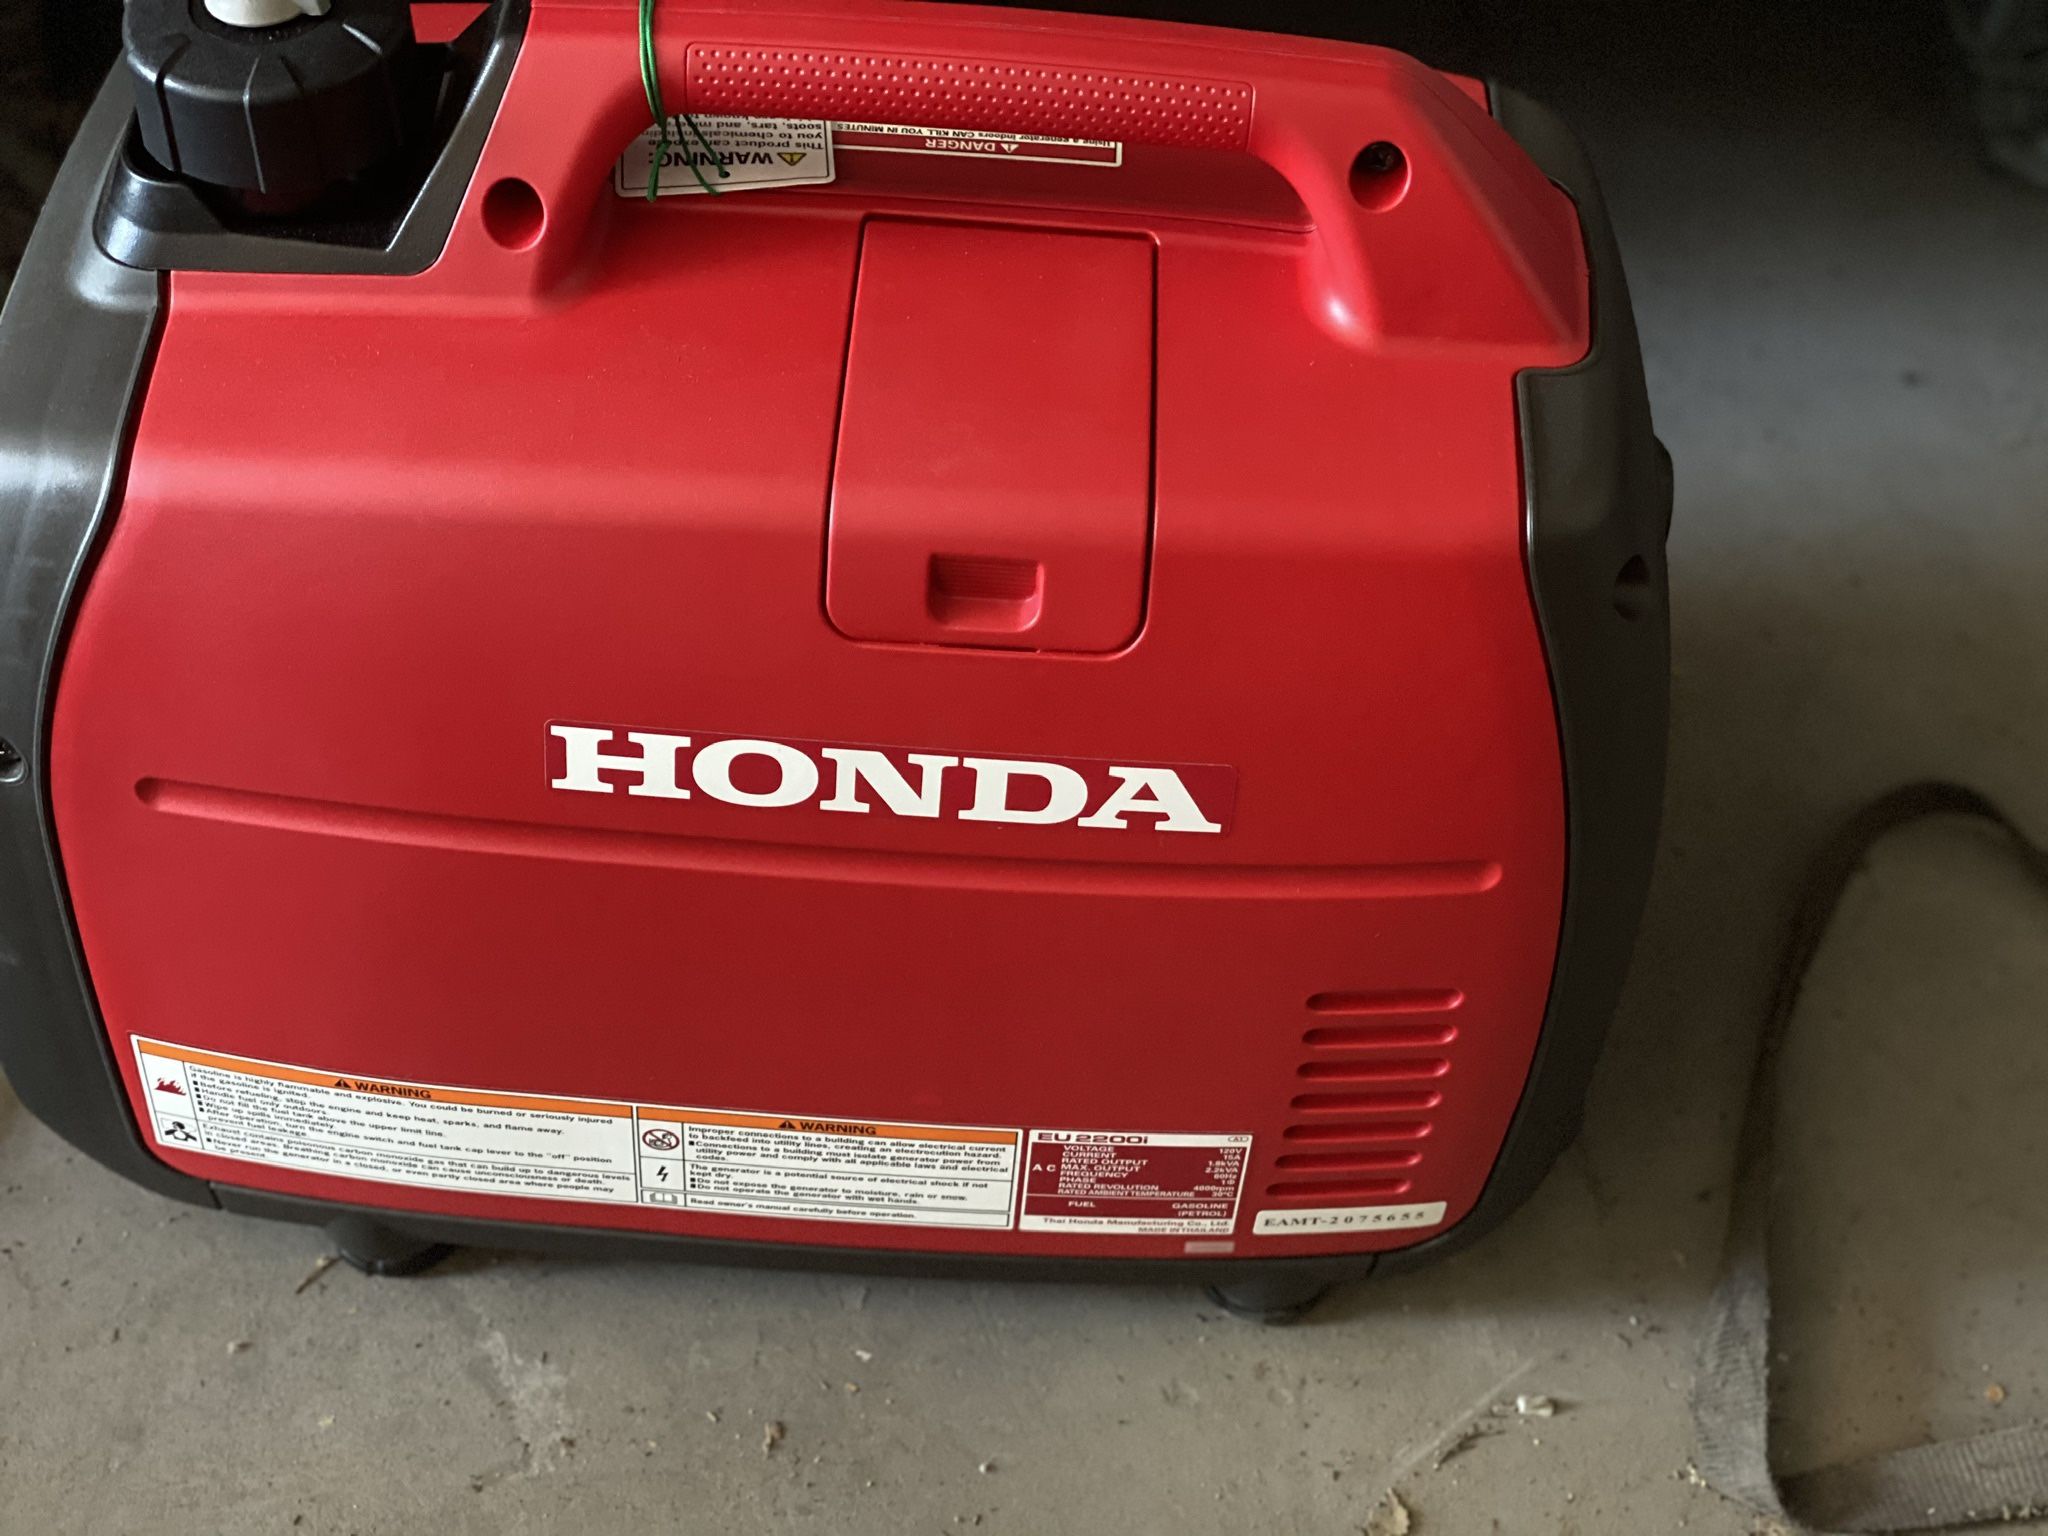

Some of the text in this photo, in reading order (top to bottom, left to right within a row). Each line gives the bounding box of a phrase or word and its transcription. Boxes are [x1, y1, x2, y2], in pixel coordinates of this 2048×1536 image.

[717, 121, 741, 129] and
[747, 121, 777, 130] tars,
[782, 122, 822, 130] soots,
[837, 122, 884, 132] MINUTES
[703, 130, 774, 139] chemicals
[901, 127, 923, 135] YOU
[979, 132, 1016, 141] indoors
[735, 140, 790, 149] product
[795, 141, 824, 150] This
[925, 138, 996, 152] DANGER
[550, 725, 1222, 833] HONDA
[354, 1080, 432, 1099] WARNING
[354, 1093, 402, 1106] explosive.
[408, 1100, 427, 1108] You
[429, 1102, 458, 1111] could
[475, 1107, 513, 1116] burned
[529, 1112, 575, 1122] seriously
[577, 1116, 613, 1125] injured
[800, 1121, 877, 1136] WARNING
[688, 1125, 735, 1136] Improper
[737, 1129, 798, 1139] connections
[824, 1136, 864, 1145] building
[917, 1142, 966, 1150] electrical
[701, 1133, 749, 1142] backfeed
[773, 1139, 801, 1148] utility
[804, 1141, 830, 1150] lines,
[833, 1143, 875, 1153] creating
[894, 1147, 961, 1156] electrocution
[694, 1140, 757, 1150] Connections
[782, 1147, 823, 1156] building
[889, 1154, 939, 1163] generator
[695, 1153, 728, 1161] codes.
[695, 1147, 722, 1155] utility
[781, 1154, 818, 1162] comply
[859, 1159, 911, 1168] applicable
[1093, 1164, 1140, 1172] OUTPUT
[689, 1170, 711, 1178] kept
[710, 1165, 760, 1175] generator
[783, 1170, 827, 1180] potential
[879, 1177, 927, 1185] electrical
[1059, 1170, 1129, 1178] FREQUENCY
[732, 1181, 768, 1189] expose
[789, 1184, 838, 1194] generator
[854, 1189, 900, 1197] moisture,
[732, 1186, 770, 1195] operate
[790, 1190, 841, 1200] generator
[689, 1197, 715, 1205] Read
[717, 1199, 753, 1207] owner's
[755, 1202, 790, 1210] manual
[792, 1205, 833, 1214] carefully
[868, 1210, 915, 1219] operation.
[1177, 1209, 1227, 1217] (PETROL)
